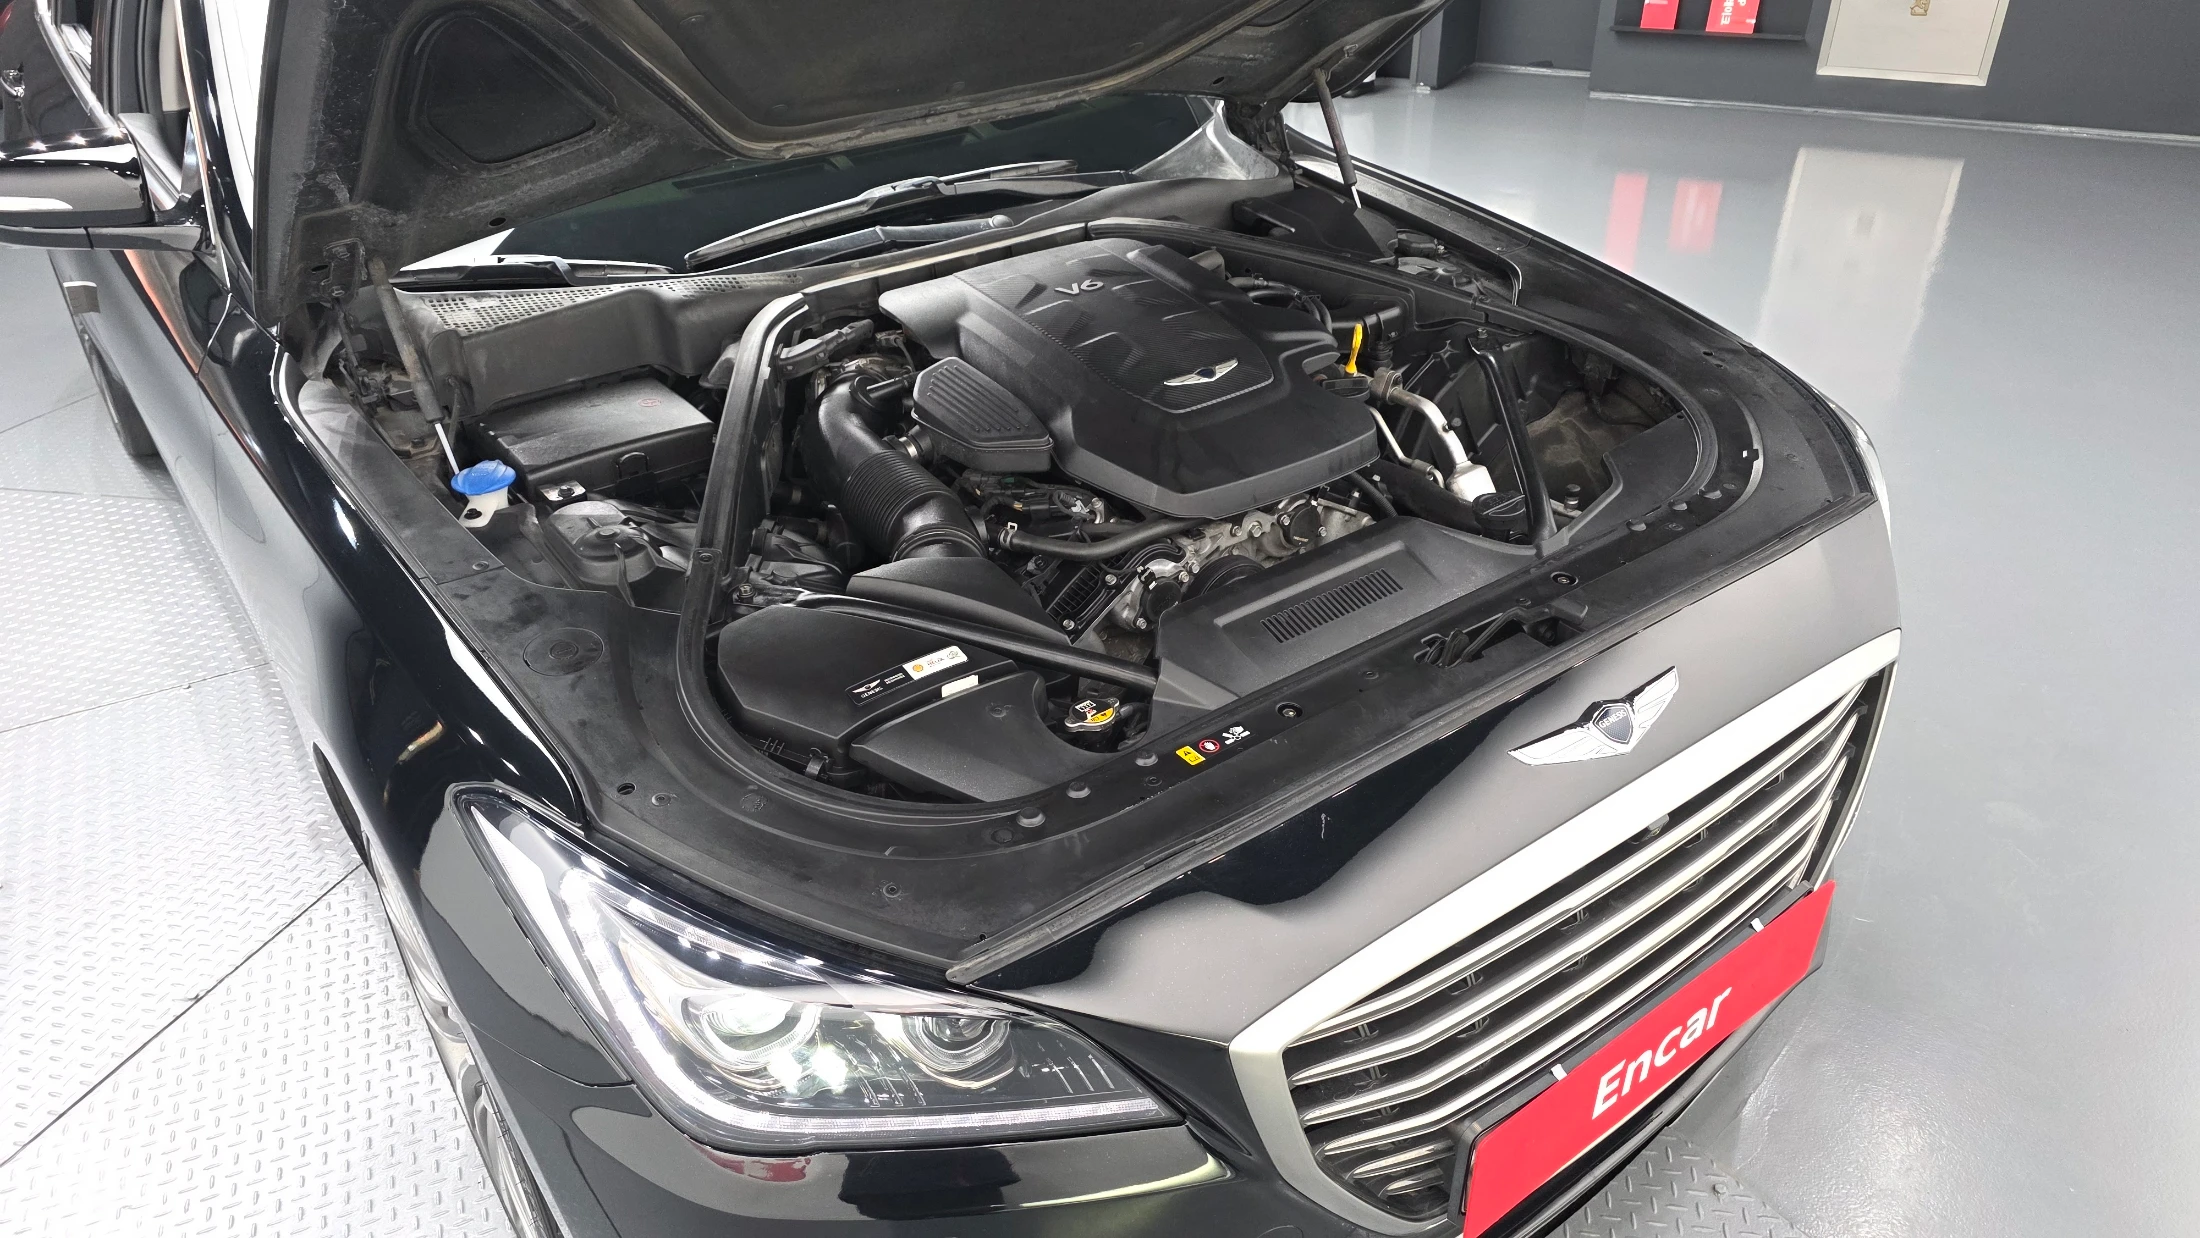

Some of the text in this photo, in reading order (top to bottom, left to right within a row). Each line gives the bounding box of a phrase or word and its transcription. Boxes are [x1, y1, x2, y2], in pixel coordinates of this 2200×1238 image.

[1054, 278, 1105, 295] V6
[1598, 709, 1628, 728] GENESIS
[1592, 986, 1733, 1121] Encar
